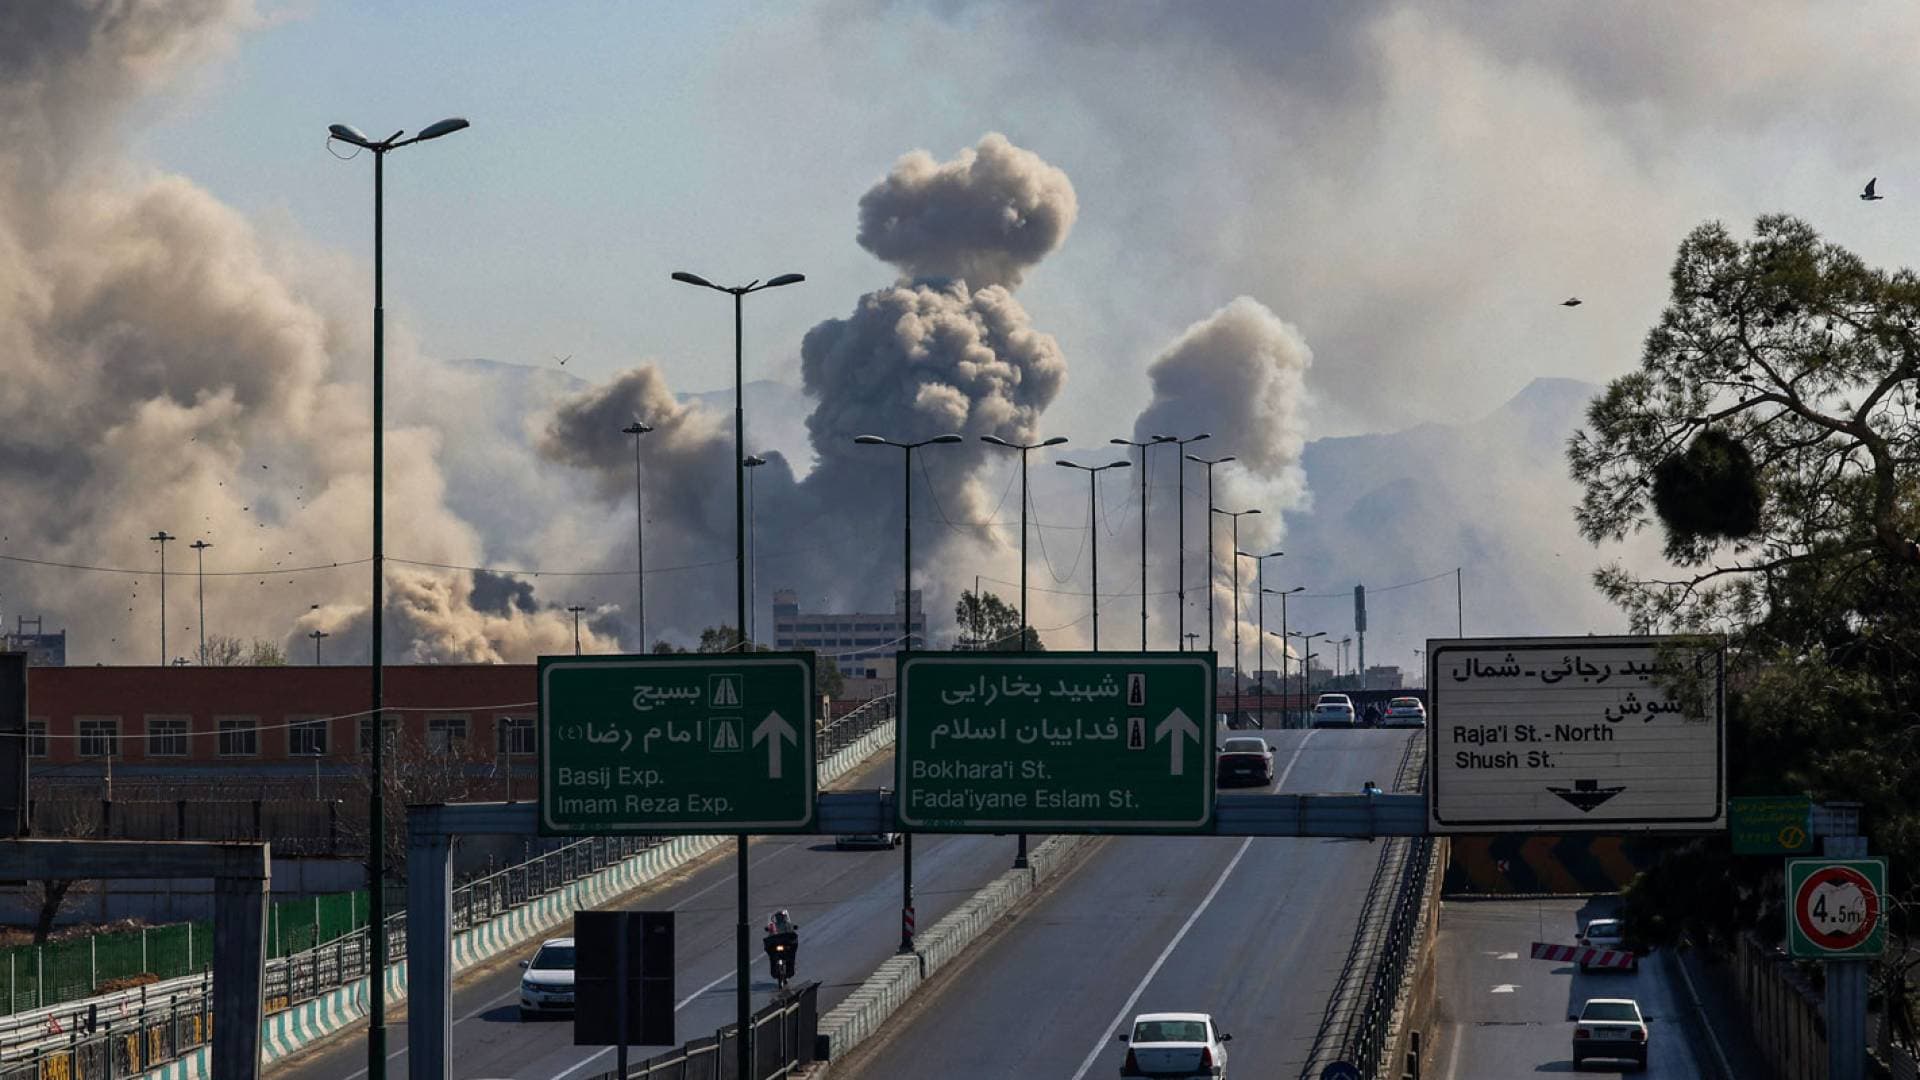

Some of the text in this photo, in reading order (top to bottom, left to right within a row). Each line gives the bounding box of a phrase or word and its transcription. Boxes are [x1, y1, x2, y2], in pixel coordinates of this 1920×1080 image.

[632, 685, 701, 711] بسیج
[941, 673, 1120, 707] شهید بخارایی
[643, 720, 702, 754] امام
[930, 716, 1120, 750] فداییان اسلام
[1453, 724, 1508, 747] Raja'i
[912, 759, 1053, 780] Bokhara'i St.
[1455, 750, 1556, 769] Shush St.
[558, 766, 664, 790] Basij Exp.
[558, 793, 734, 815] Imam Reza Exp.
[912, 788, 1139, 812] Fada'iyane Eslam St.
[1812, 893, 1861, 923] 4.5m
